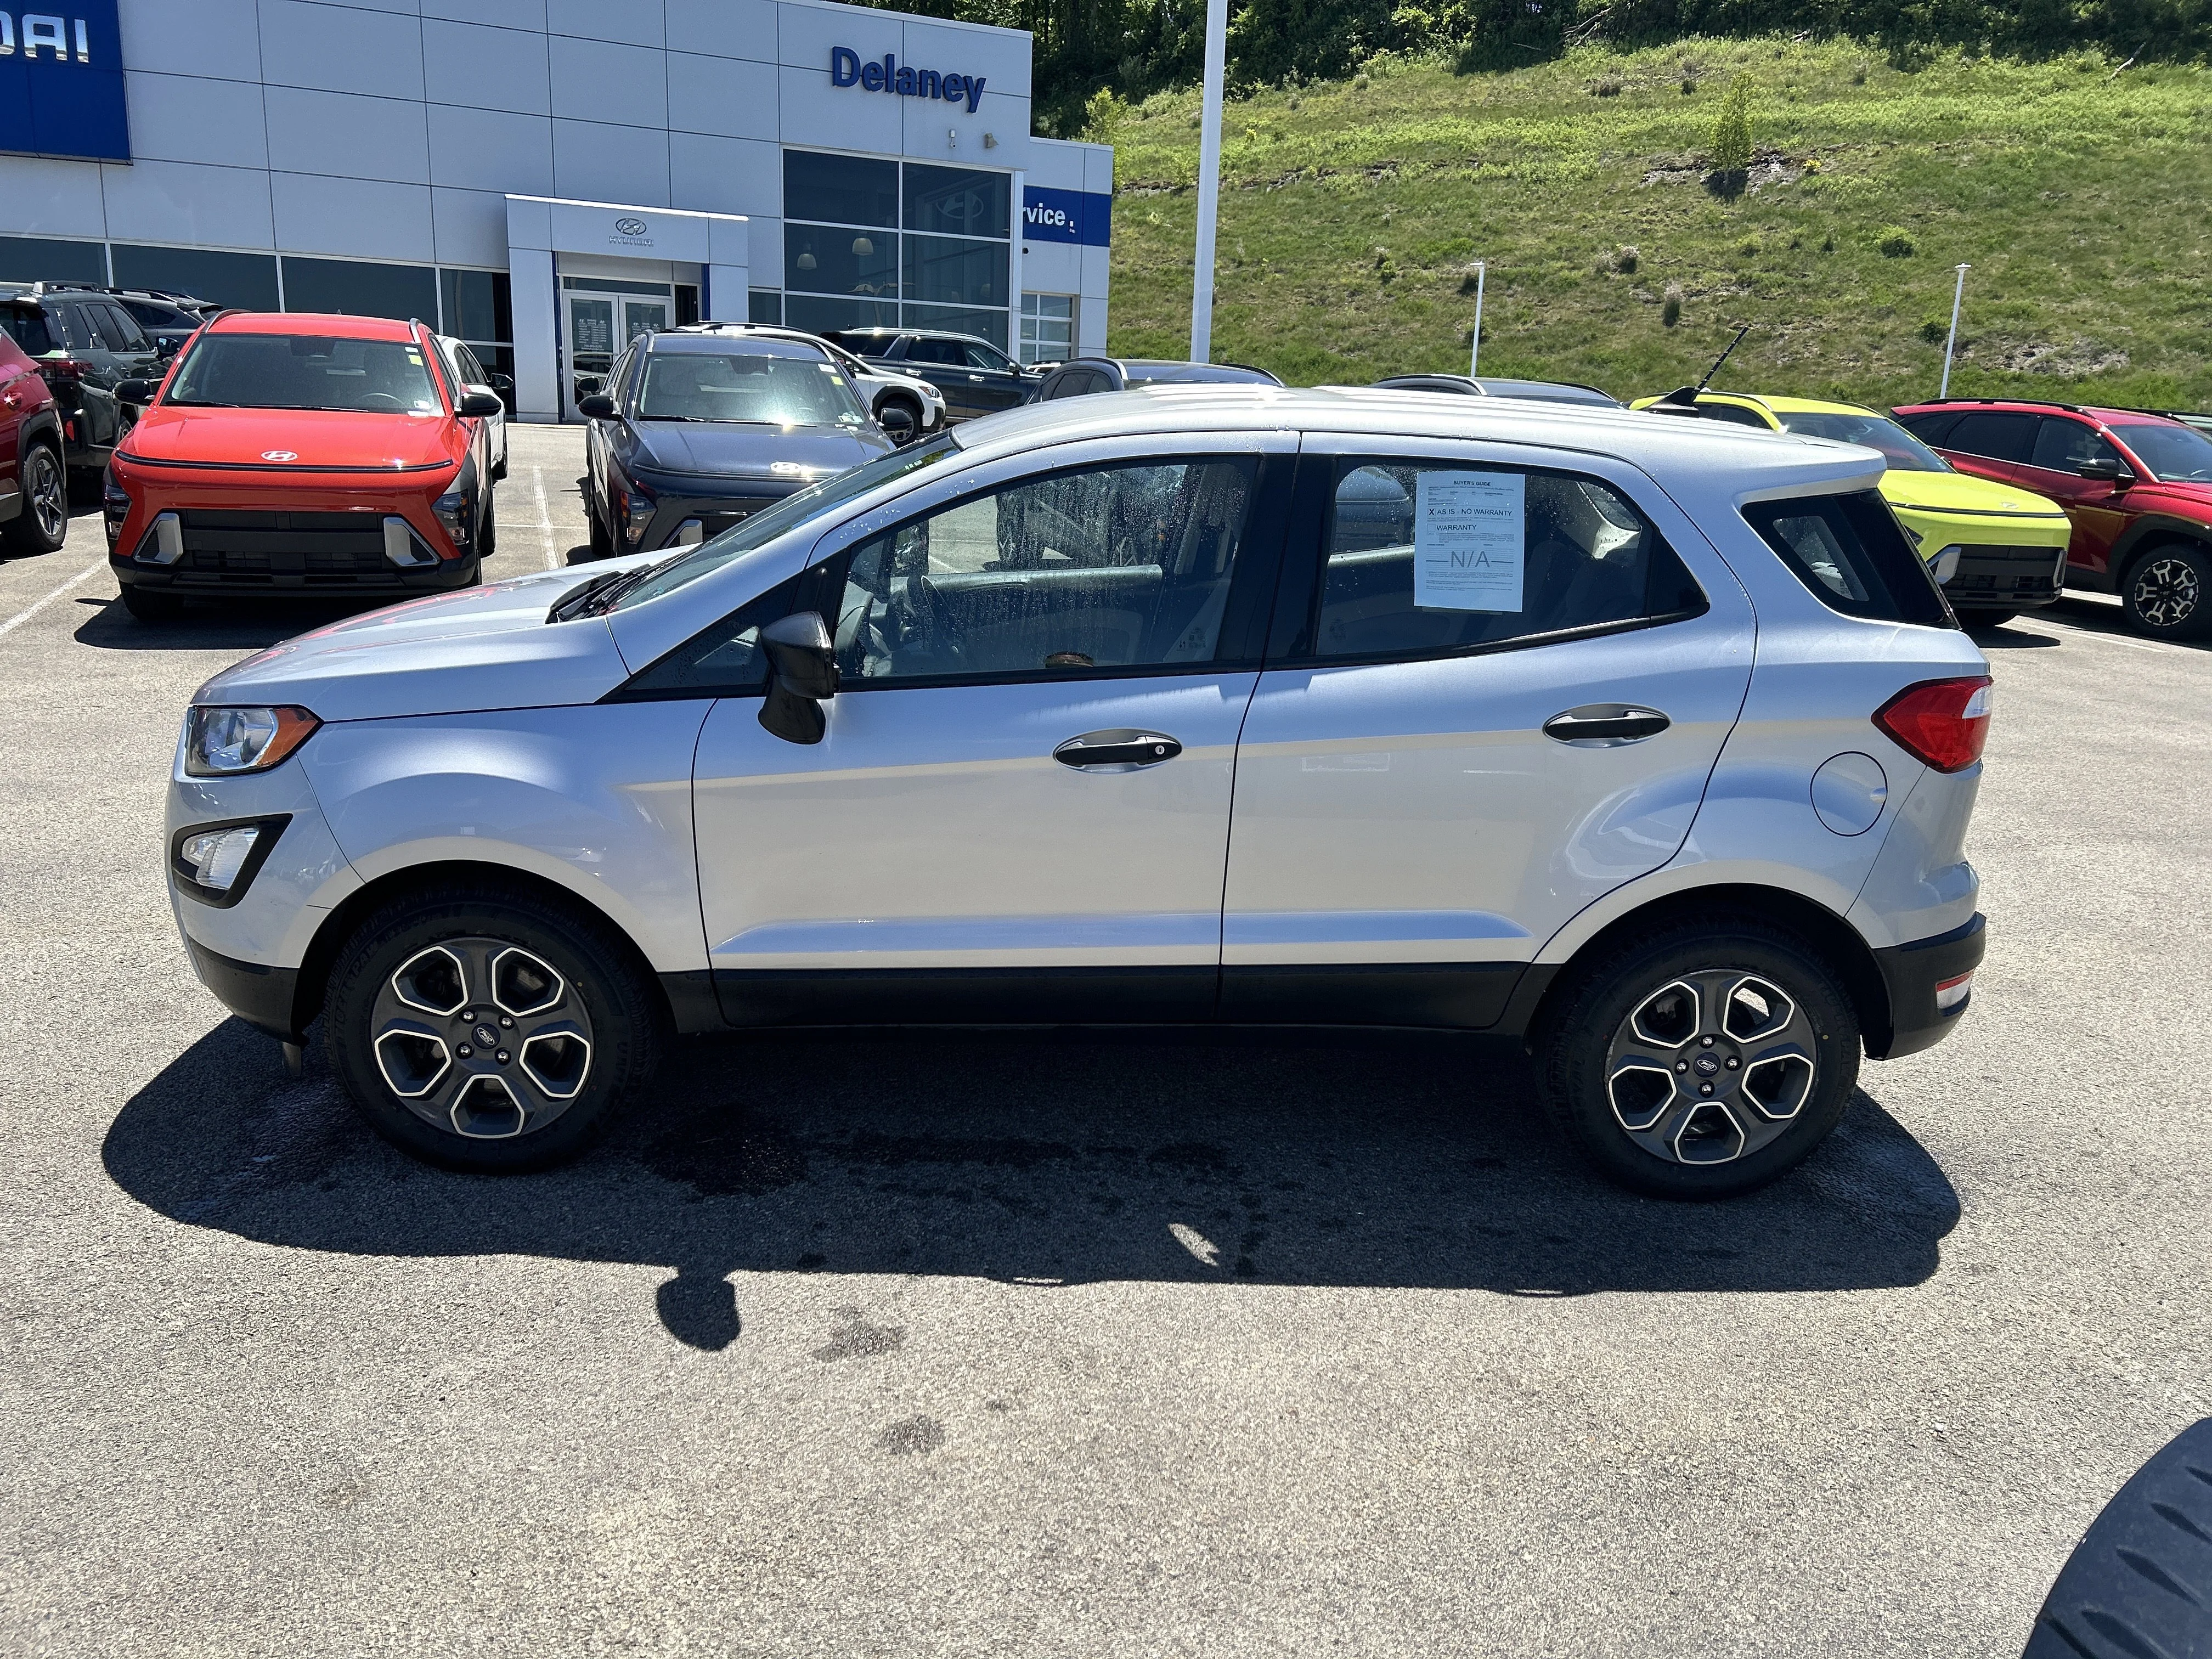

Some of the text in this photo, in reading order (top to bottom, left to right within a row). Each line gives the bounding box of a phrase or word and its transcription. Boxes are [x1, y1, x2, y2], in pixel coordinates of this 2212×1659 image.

[832, 46, 986, 113] Delaney
[609, 235, 654, 247] HYUNDAI
[1451, 550, 1490, 568] N/A
